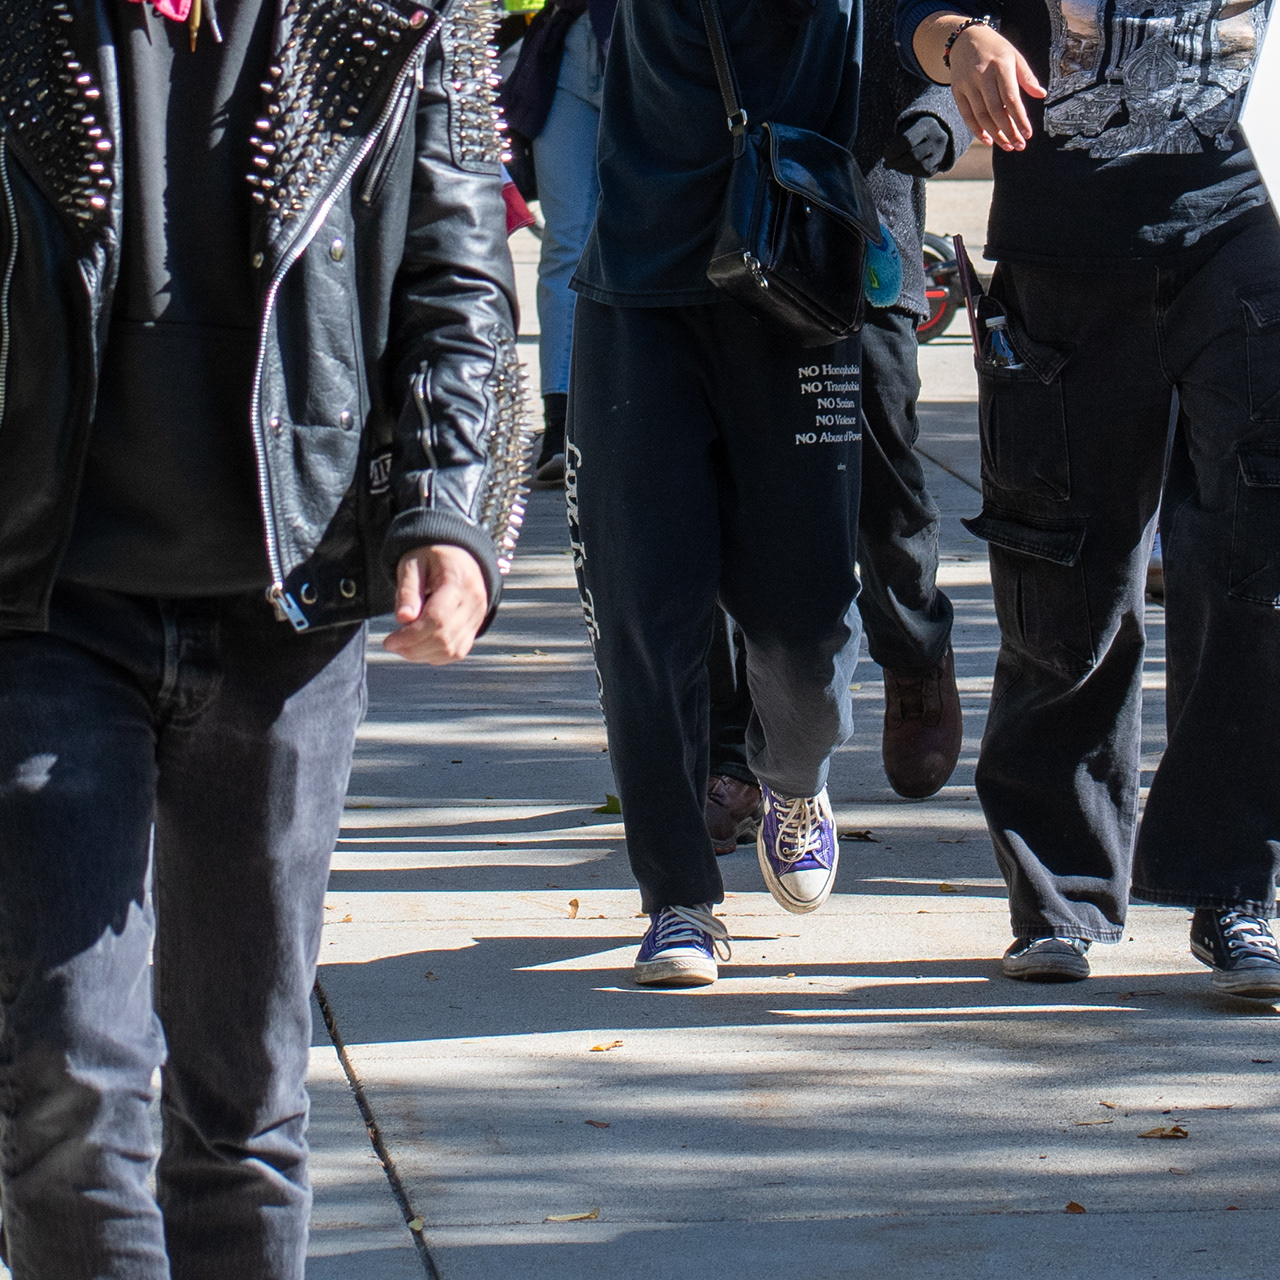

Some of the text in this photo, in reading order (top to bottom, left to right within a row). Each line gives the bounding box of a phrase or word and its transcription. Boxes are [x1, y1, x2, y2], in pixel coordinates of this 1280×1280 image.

[798, 365, 819, 378] NO
[801, 381, 822, 394] NO
[817, 398, 835, 409] NO
[815, 415, 834, 426] NO
[795, 432, 817, 445] NO
